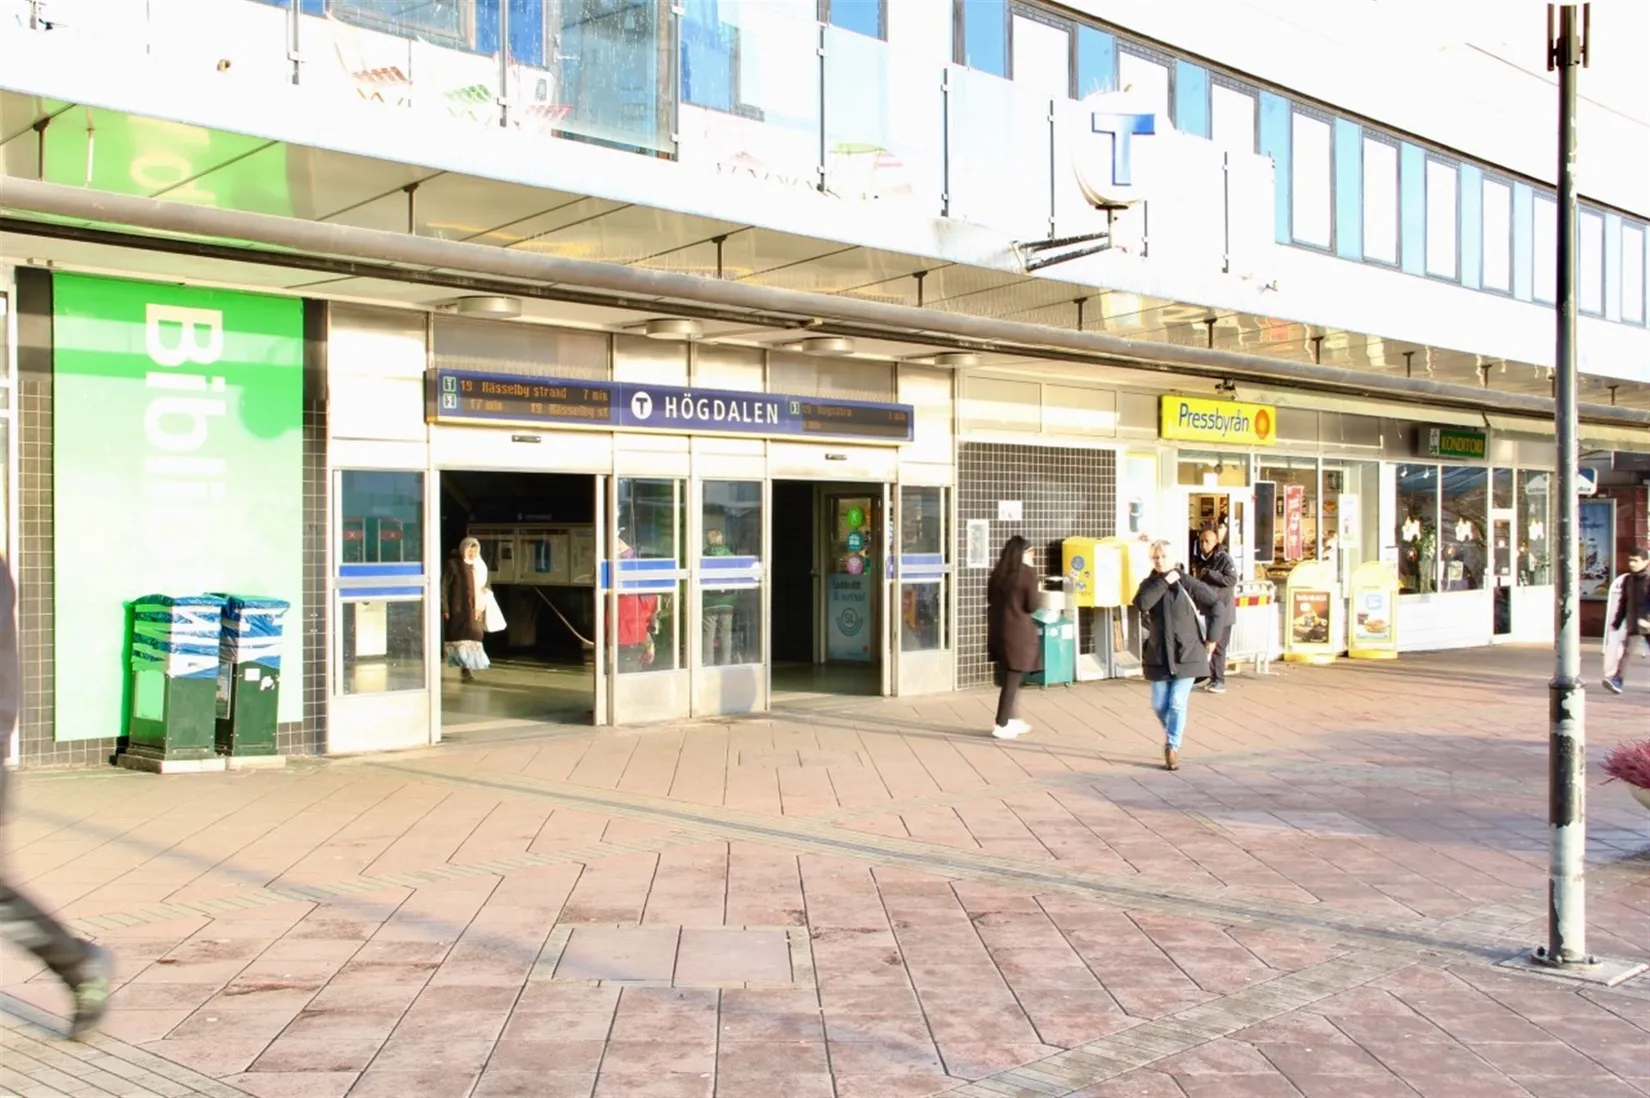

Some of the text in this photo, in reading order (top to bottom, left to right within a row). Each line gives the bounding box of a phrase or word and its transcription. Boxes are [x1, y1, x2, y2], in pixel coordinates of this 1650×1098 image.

[1091, 112, 1155, 186] T
[460, 380, 473, 392] 19
[533, 384, 567, 399] strand
[592, 390, 608, 402] min
[665, 392, 779, 425] HÖGDALEN
[1178, 402, 1249, 437] Pressbyrån
[844, 612, 854, 624] SL
